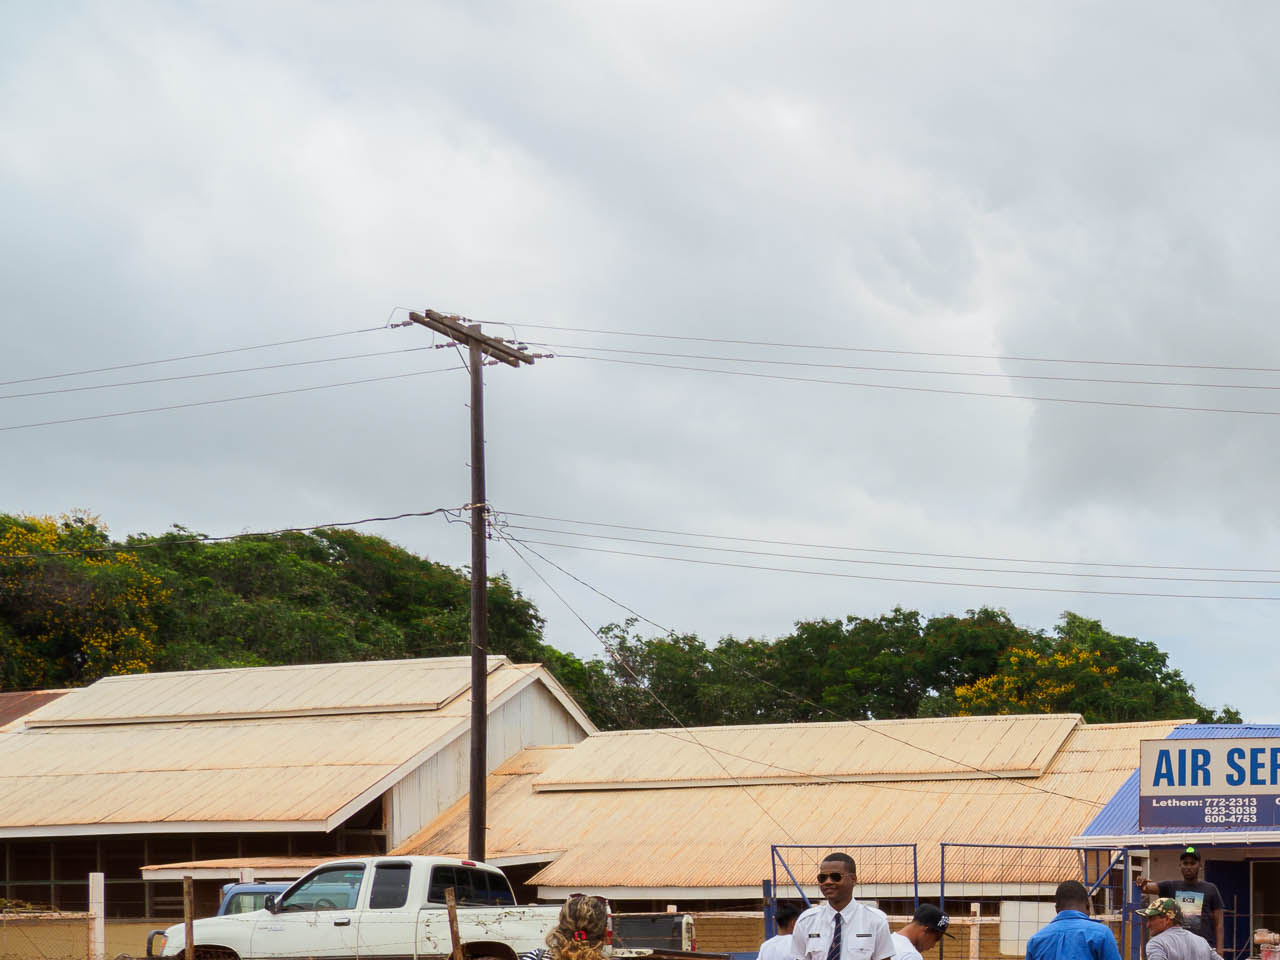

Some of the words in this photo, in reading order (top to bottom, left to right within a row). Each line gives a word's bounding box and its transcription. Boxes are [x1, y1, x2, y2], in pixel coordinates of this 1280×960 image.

[1152, 748, 1211, 787] AIR
[1152, 798, 1203, 807] Lethem:
[1204, 797, 1257, 806] 772-2313
[1204, 806, 1257, 815] 623-3039
[1204, 814, 1257, 823] 600-4753
